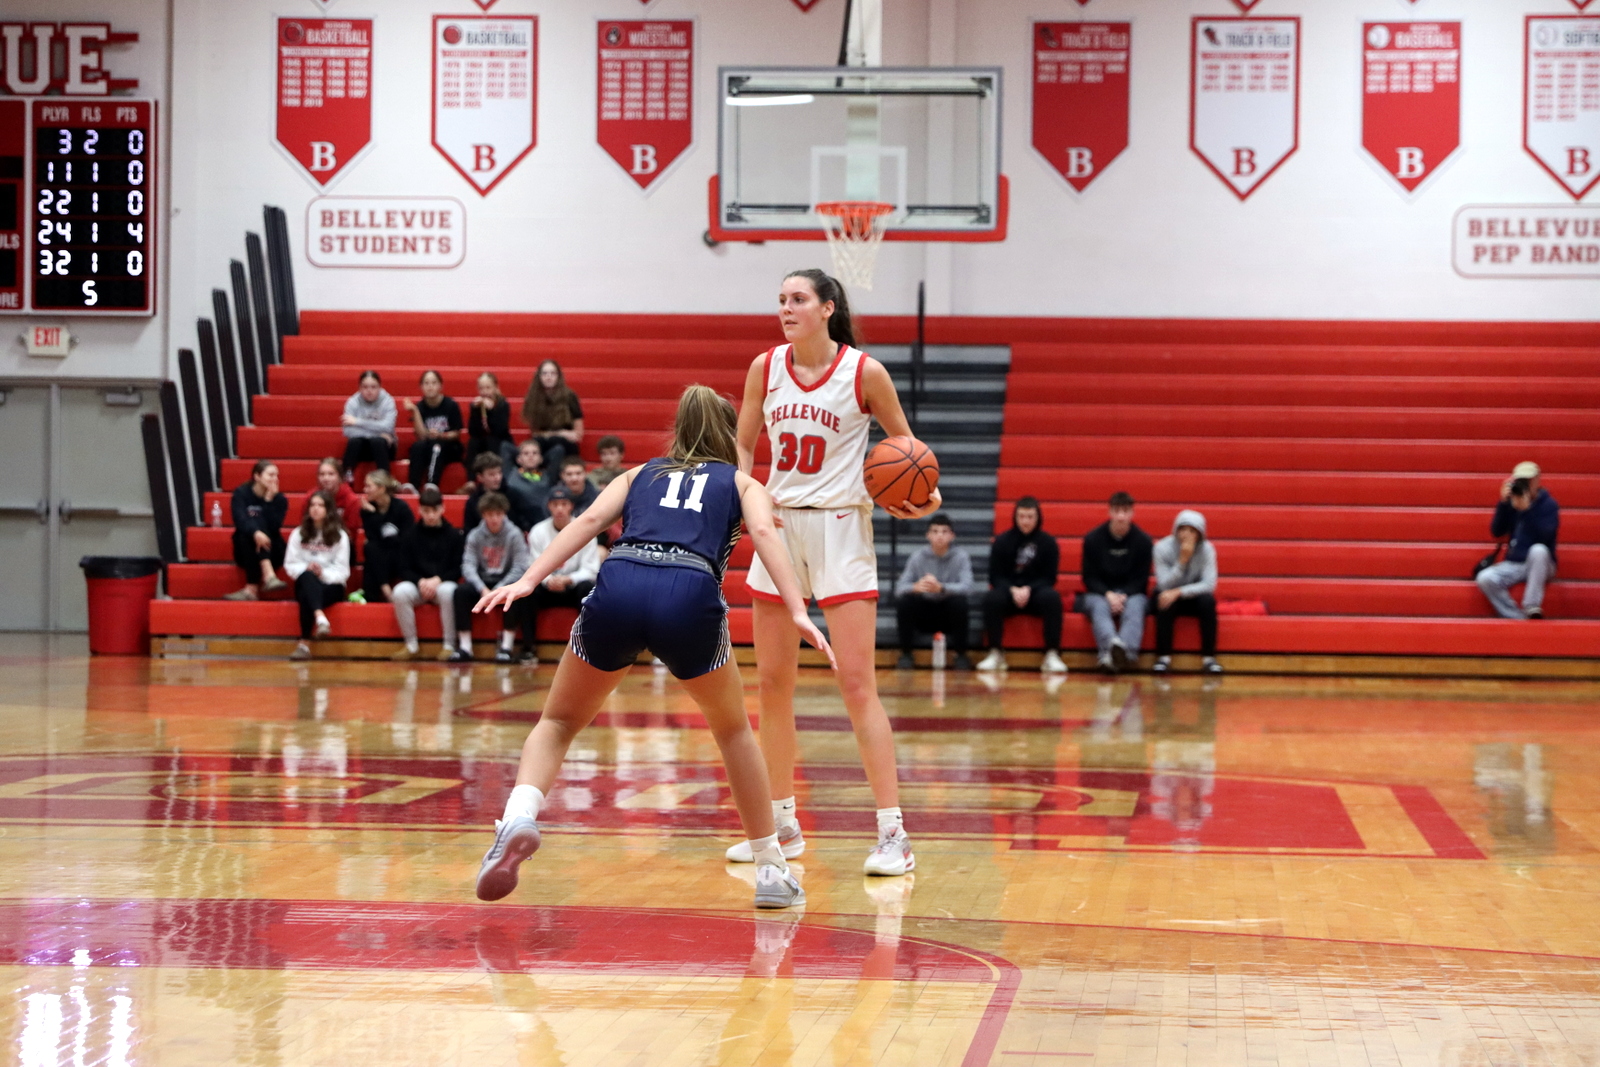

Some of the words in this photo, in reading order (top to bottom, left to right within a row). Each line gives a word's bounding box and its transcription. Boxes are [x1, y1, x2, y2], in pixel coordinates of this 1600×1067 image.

[306, 29, 368, 45] BASKETBALL
[467, 31, 527, 46] BASKETBALL
[629, 31, 687, 47] WRESTLING
[1395, 32, 1454, 48] BASEBALL
[42, 107, 69, 122] PLYR
[82, 107, 101, 122] FLS
[116, 107, 137, 122] PTS
[59, 129, 72, 155] 3
[84, 129, 99, 155] 2
[128, 129, 143, 155] 0
[309, 141, 337, 171] B
[472, 144, 497, 172] B
[630, 144, 658, 175] B
[1066, 147, 1095, 178] B
[1231, 147, 1257, 177] B
[1396, 147, 1426, 179] B
[1566, 147, 1591, 176] B
[47, 162, 72, 183] 11
[92, 162, 99, 183] 1
[128, 160, 143, 186] 0
[38, 189, 71, 215] 22
[92, 192, 98, 213] 1
[127, 190, 143, 215] 0
[38, 219, 71, 245] 24
[92, 222, 98, 243] 1
[127, 222, 143, 243] 4
[320, 209, 453, 229] BELLEVUE
[320, 235, 453, 255] STUDENTS
[1473, 244, 1521, 263] PEP
[1530, 244, 1600, 263] BAND
[39, 250, 71, 275] 32
[92, 252, 98, 273] 1
[127, 250, 143, 276] 0
[82, 280, 98, 306] 5
[34, 326, 62, 347] EXIT
[771, 403, 841, 433] BELLEVUE
[776, 431, 827, 475] 30
[659, 471, 710, 513] 11
